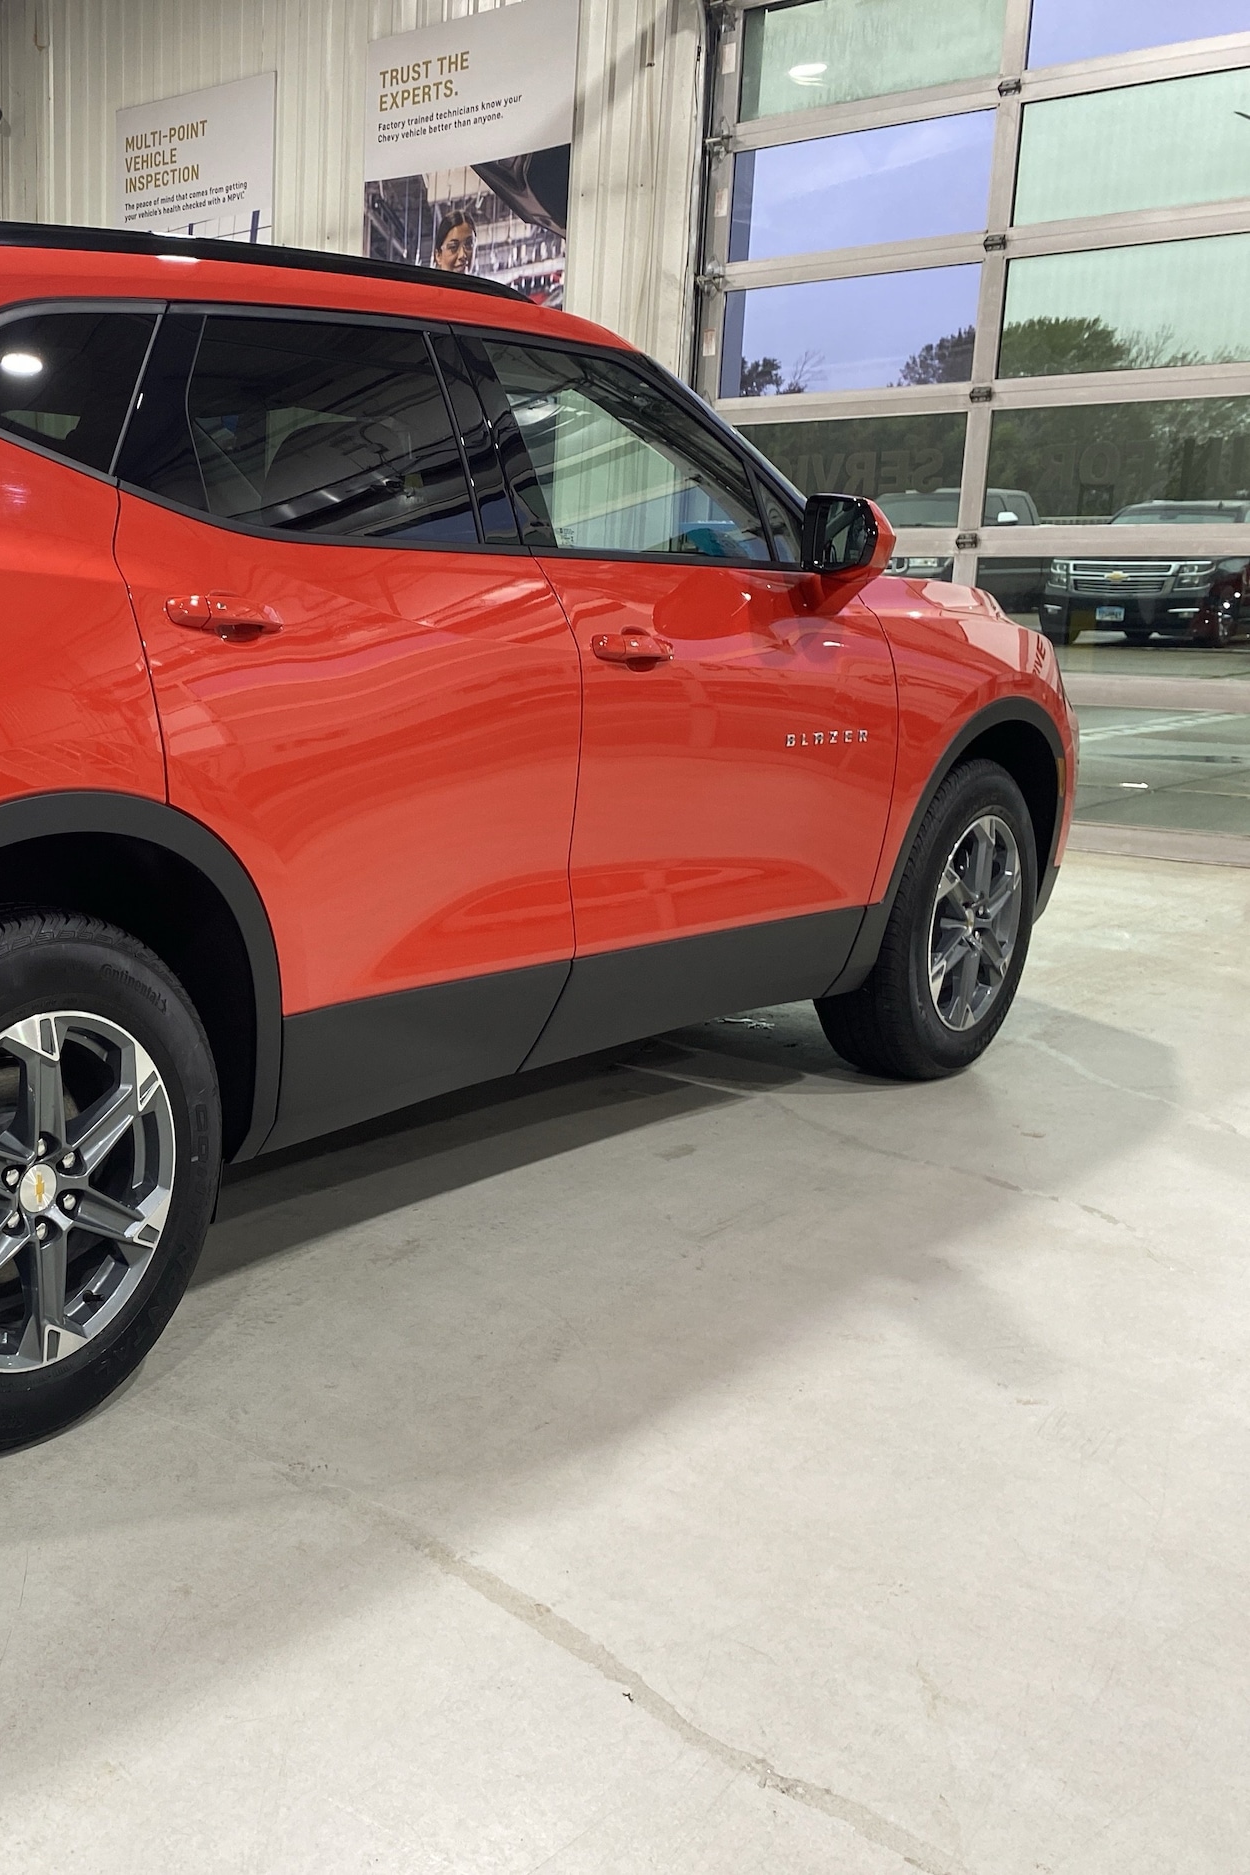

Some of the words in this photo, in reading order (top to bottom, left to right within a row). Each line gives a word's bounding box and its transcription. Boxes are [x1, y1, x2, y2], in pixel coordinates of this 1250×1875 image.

[379, 60, 432, 89] TRUST
[436, 50, 470, 76] THE
[379, 79, 459, 112] EXPERTS.
[377, 131, 399, 143] Chevy
[401, 126, 427, 139] vehicle
[428, 121, 452, 134] better
[454, 118, 471, 129] than
[473, 111, 503, 125] anyone.
[378, 118, 406, 132] Factory
[407, 112, 434, 126] trained
[435, 103, 479, 121] technicians
[481, 99, 502, 111] know
[503, 94, 522, 108] your
[125, 119, 208, 153] MULTI-POINT
[125, 147, 177, 173] VEHICLE
[125, 163, 199, 194] INSPECTION
[124, 213, 137, 224] your
[138, 208, 162, 219] vehicle's
[162, 204, 181, 214] health
[182, 199, 206, 211] checked
[207, 196, 221, 205] with
[125, 203, 135, 211] The
[136, 200, 152, 211] peace
[153, 197, 160, 206] of
[160, 194, 174, 204] mind
[175, 192, 188, 202] that
[189, 189, 208, 199] comes
[209, 186, 224, 195] from
[225, 181, 248, 194] getting
[786, 729, 868, 747] BLAZER
